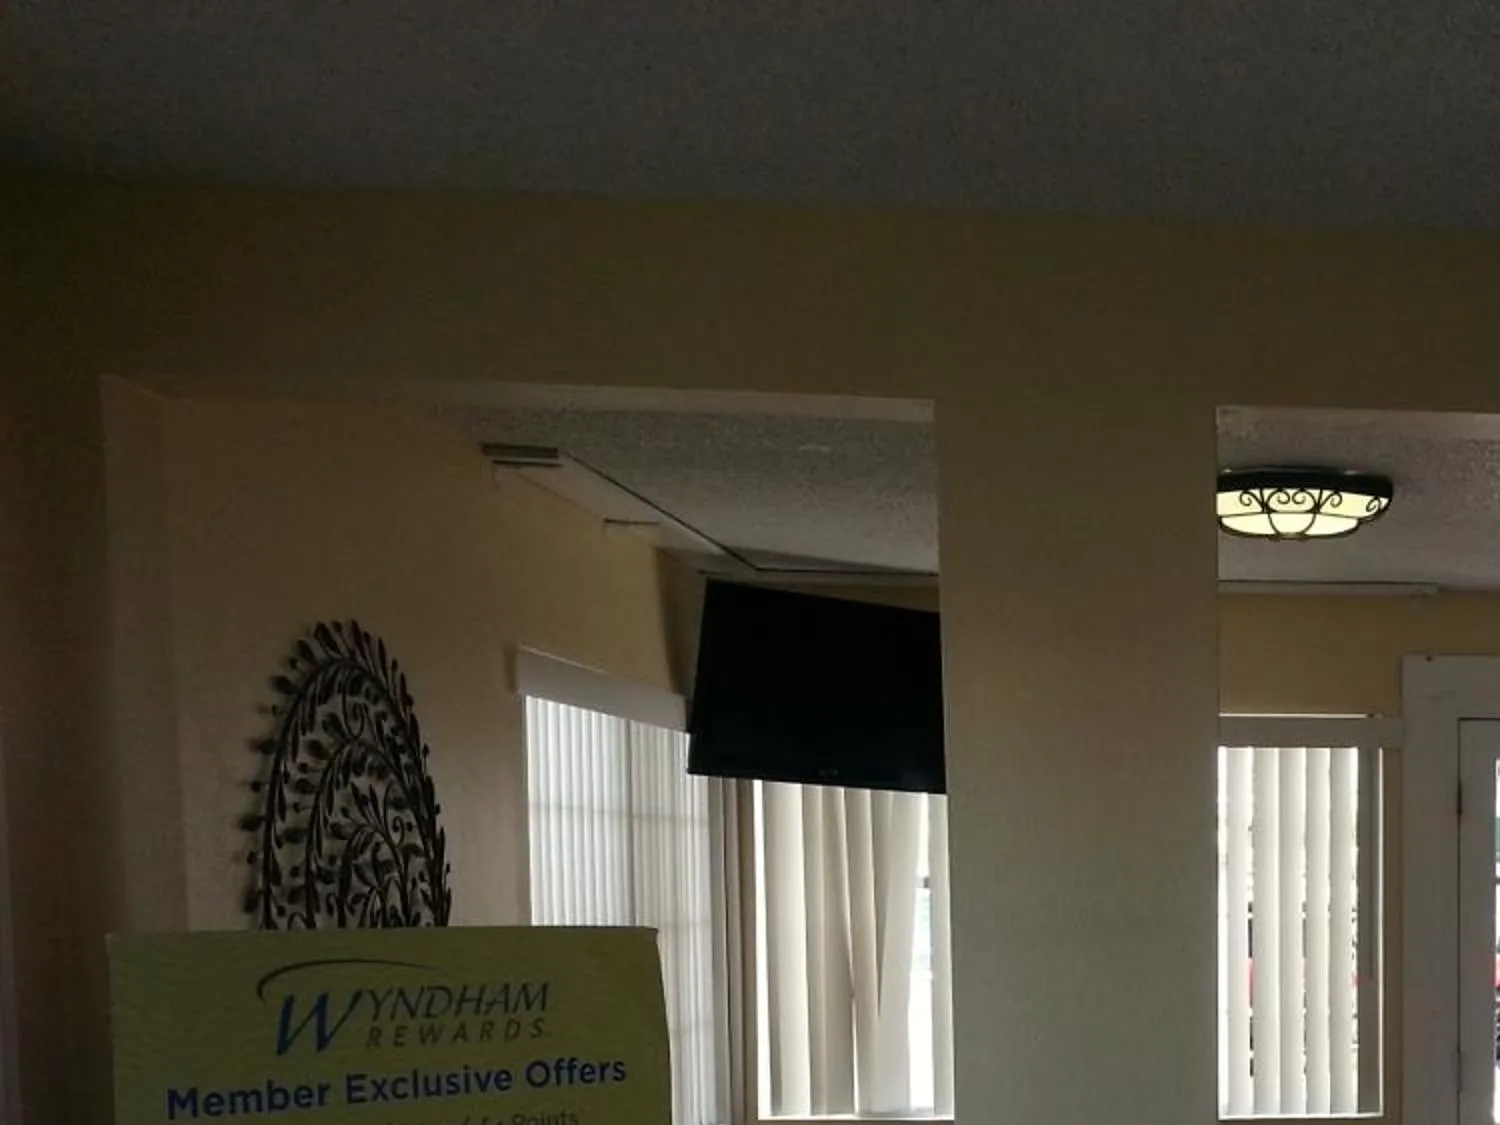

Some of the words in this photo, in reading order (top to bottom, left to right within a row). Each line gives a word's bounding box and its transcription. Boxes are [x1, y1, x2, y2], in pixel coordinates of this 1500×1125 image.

[275, 982, 550, 1056] WYNDHAM
[366, 1016, 546, 1048] REWARDS
[167, 1080, 331, 1120] Member
[346, 1064, 512, 1104] Exclusive
[526, 1057, 626, 1089] Offers
